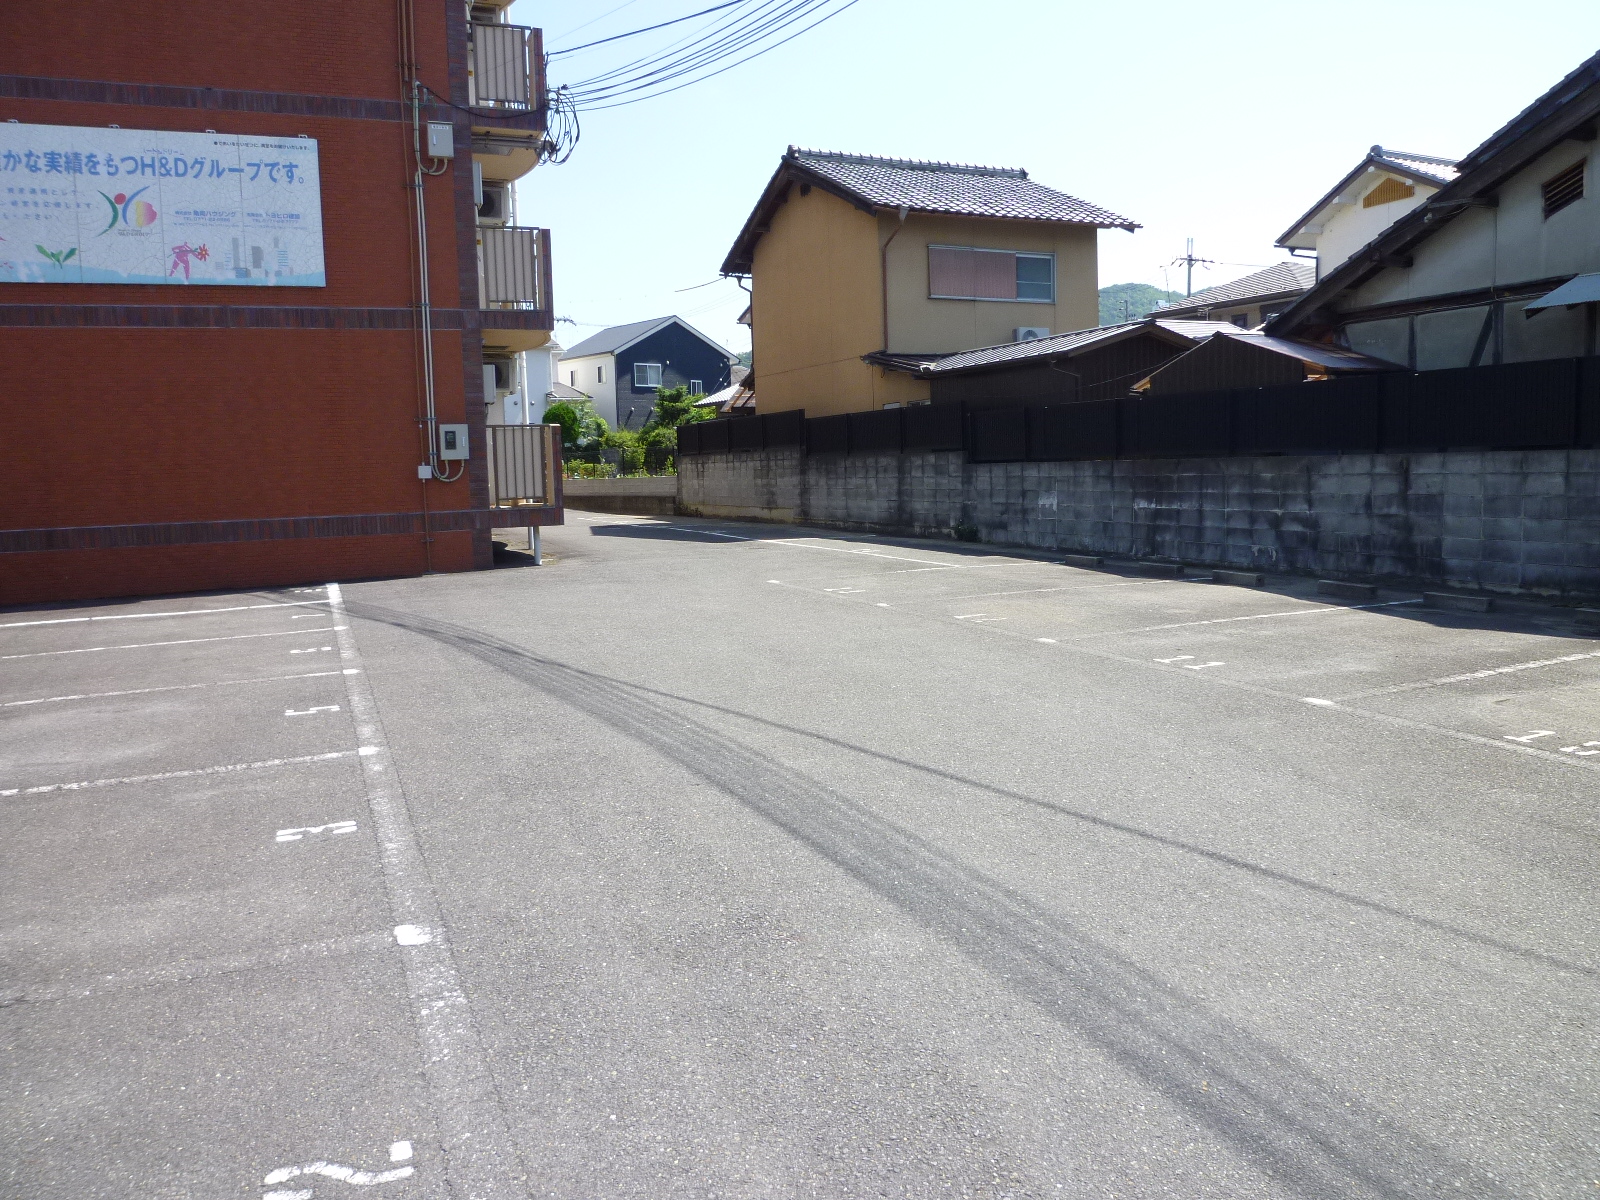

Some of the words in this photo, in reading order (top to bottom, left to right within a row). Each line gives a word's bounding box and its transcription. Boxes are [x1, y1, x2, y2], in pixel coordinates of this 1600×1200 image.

[0, 149, 305, 185] かな実績をもつH&Dグループです。
[274, 821, 359, 844] 3
